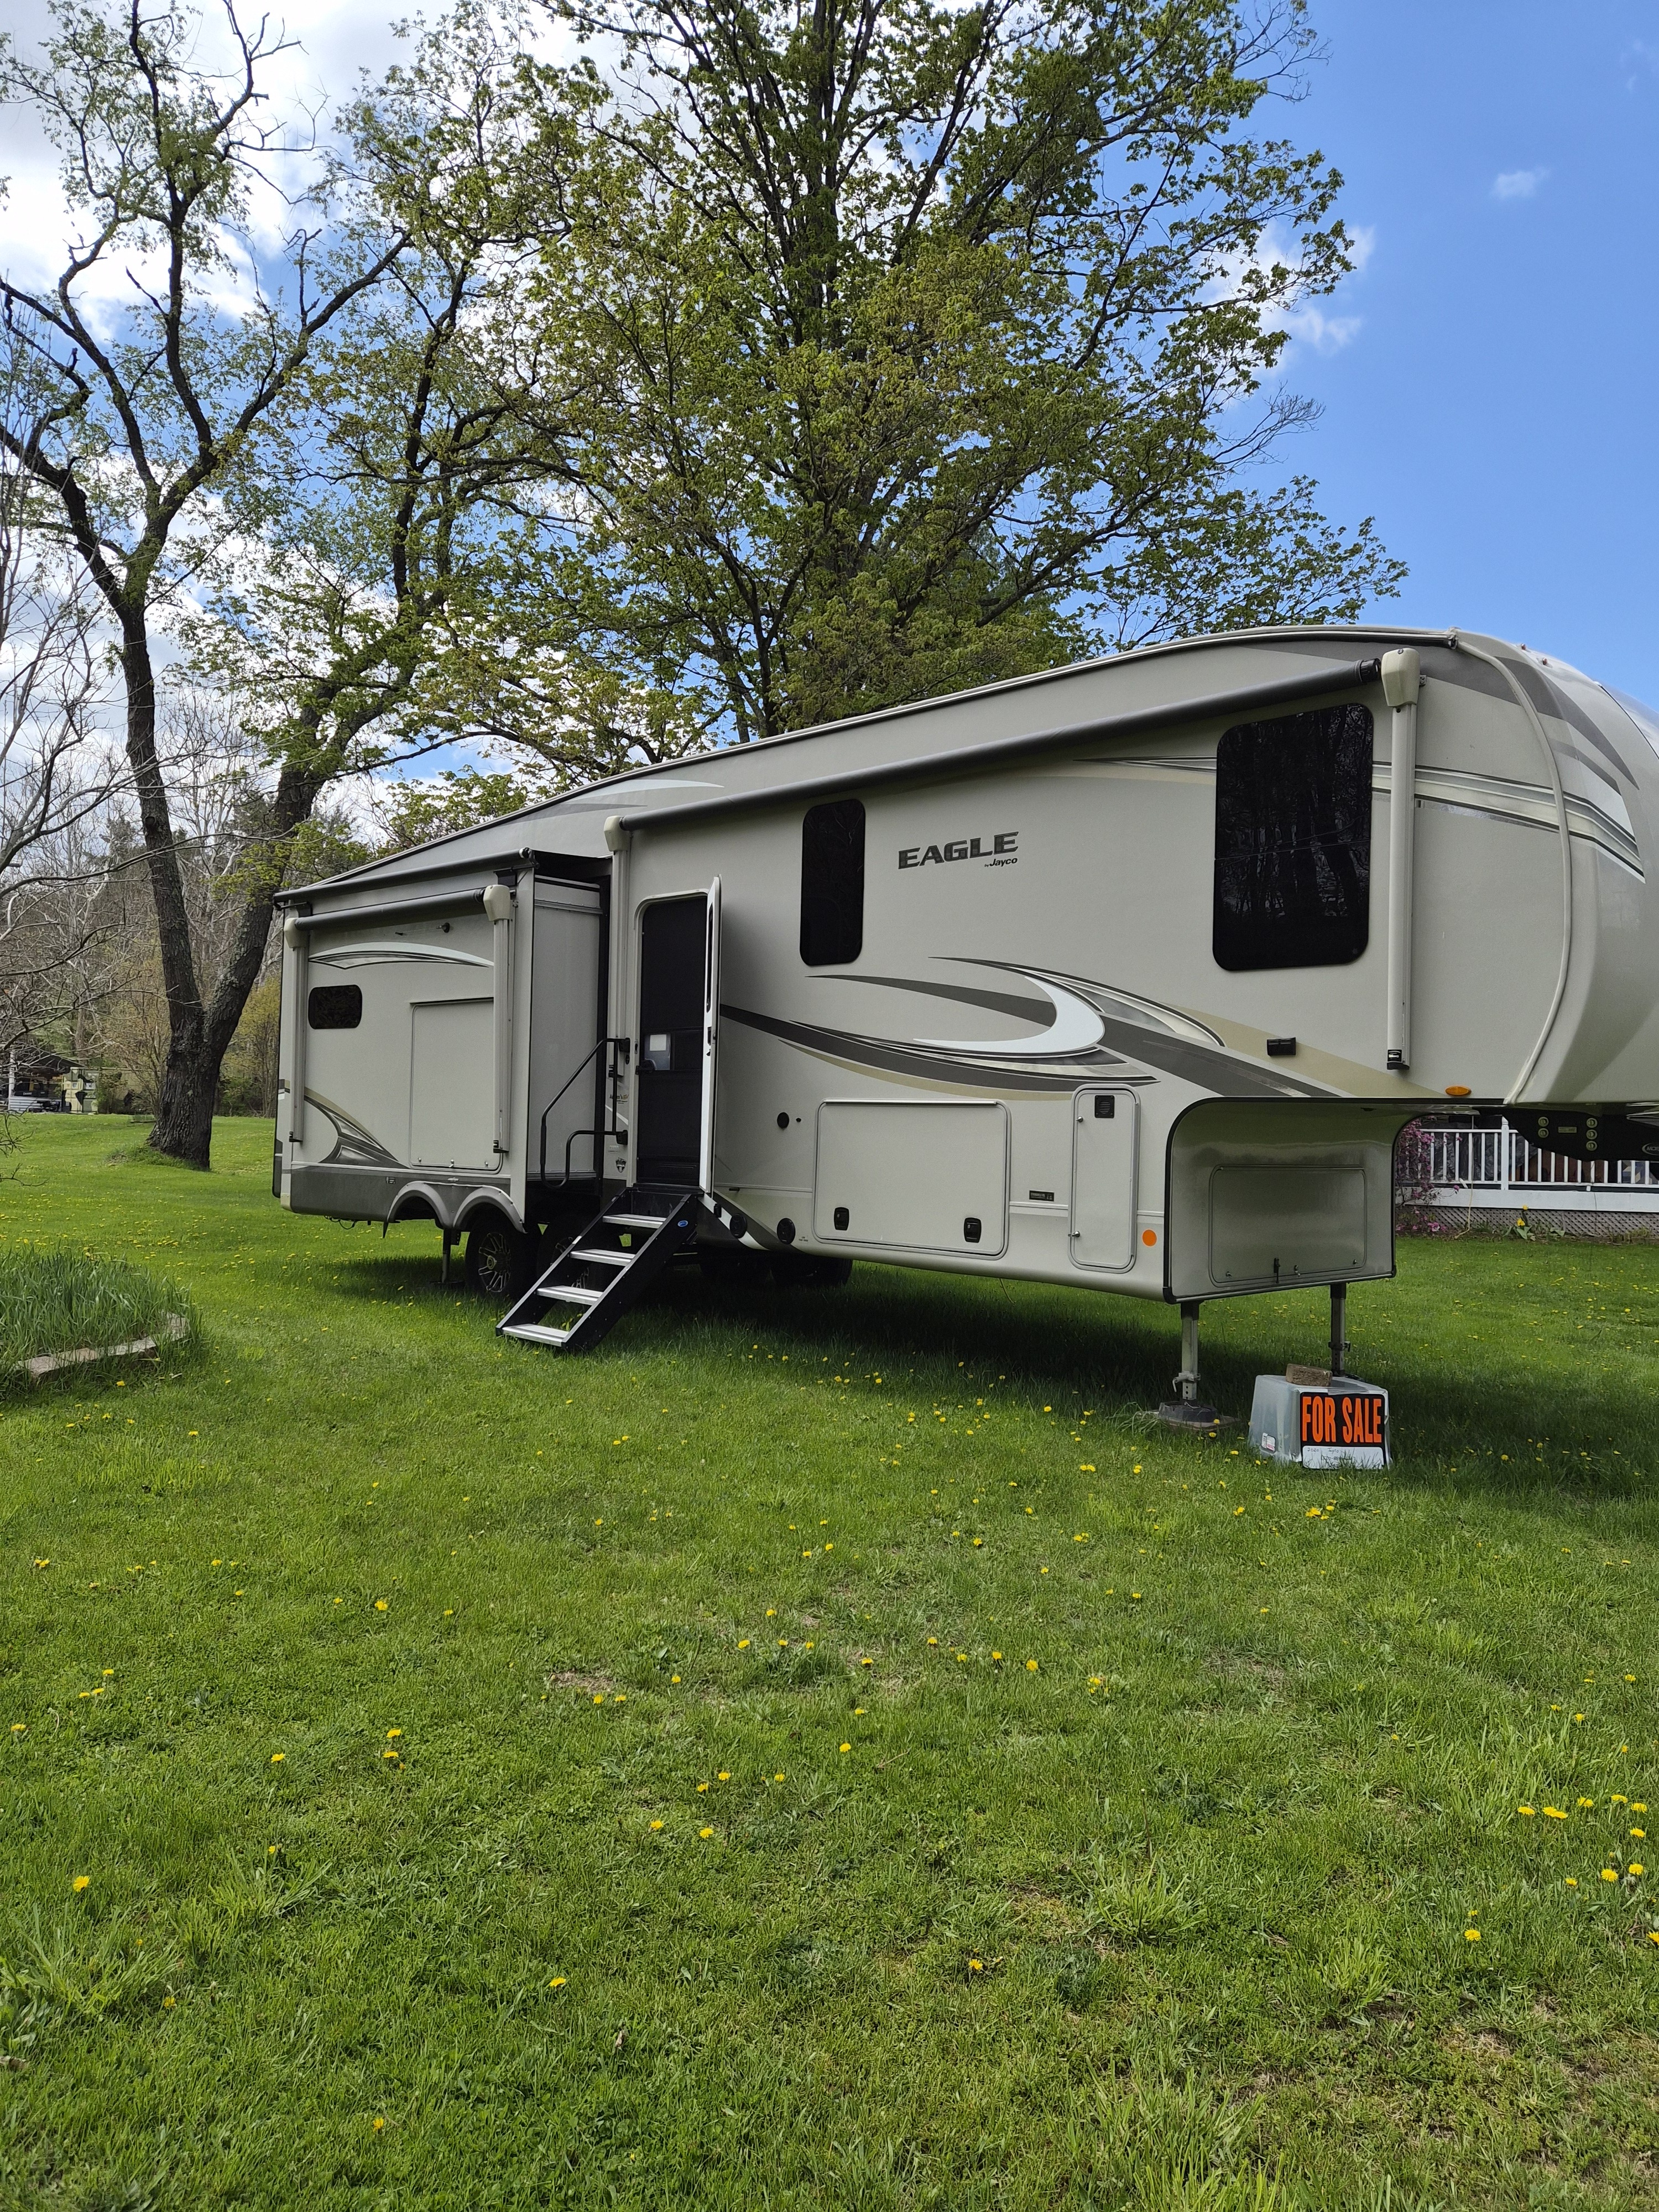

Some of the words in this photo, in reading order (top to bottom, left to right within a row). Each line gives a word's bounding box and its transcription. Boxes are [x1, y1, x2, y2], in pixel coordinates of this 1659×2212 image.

[898, 831, 1019, 870] EAGLE
[989, 858, 1018, 868] Jayco
[1302, 1396, 1336, 1442] FOR
[1342, 1397, 1382, 1443] SALE
